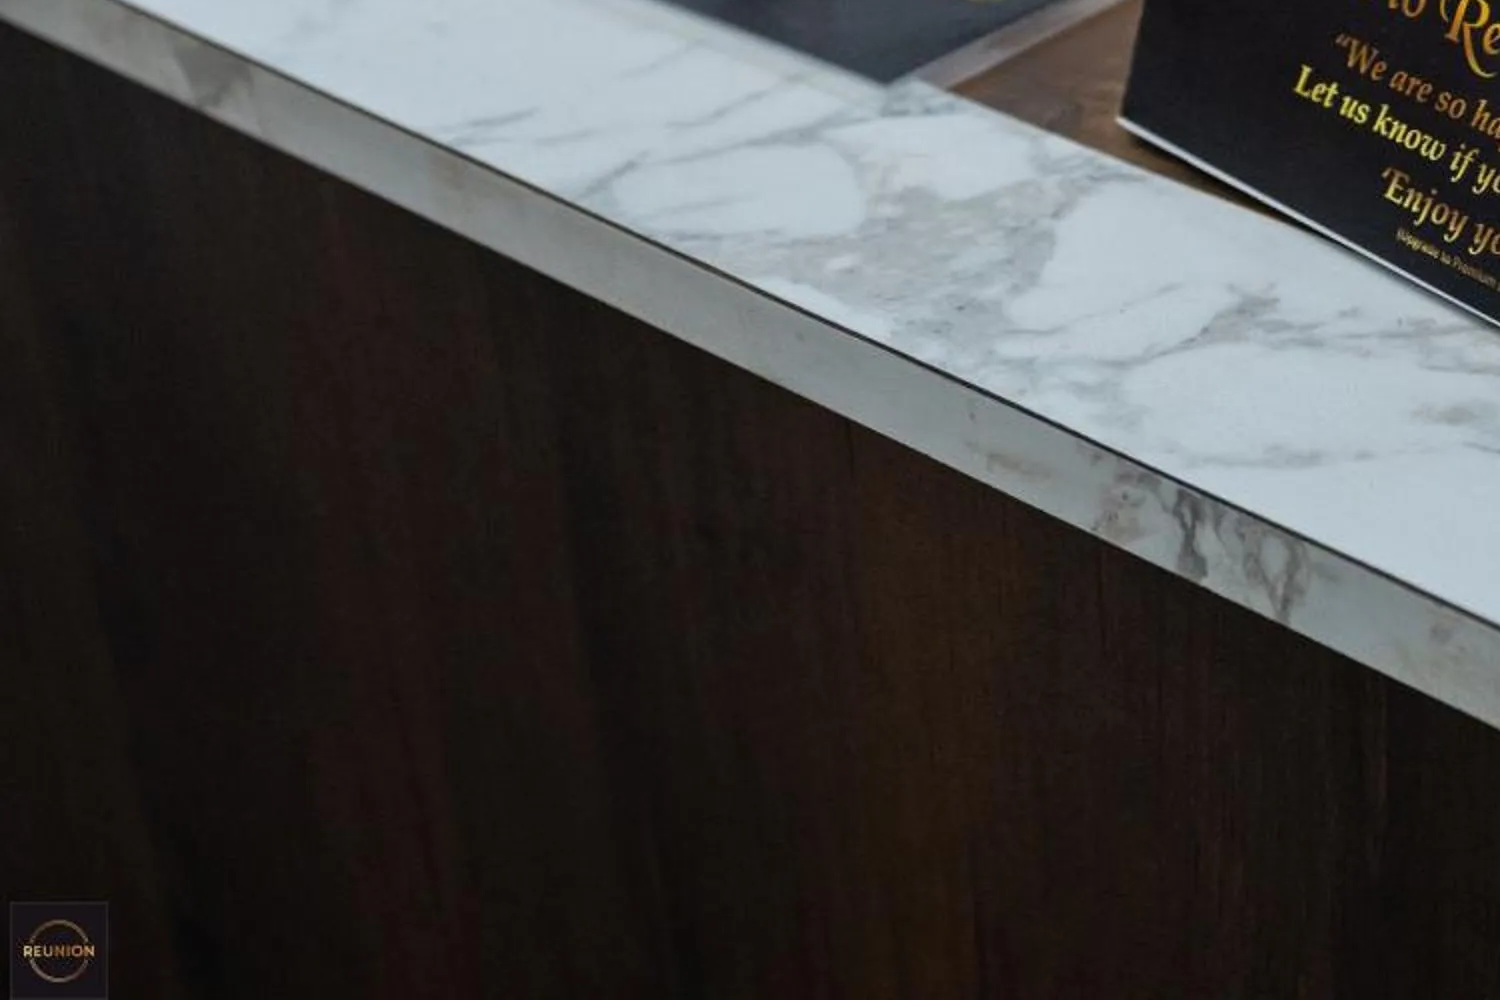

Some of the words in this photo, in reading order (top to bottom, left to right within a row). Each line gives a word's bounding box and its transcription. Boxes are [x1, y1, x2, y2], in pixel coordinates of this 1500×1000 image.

[1293, 63, 1339, 108] Let
[1340, 96, 1371, 124] us
[1373, 104, 1447, 161] know
[1449, 142, 1479, 183] if
[1389, 71, 1433, 103] are
[1434, 91, 1467, 120] so
